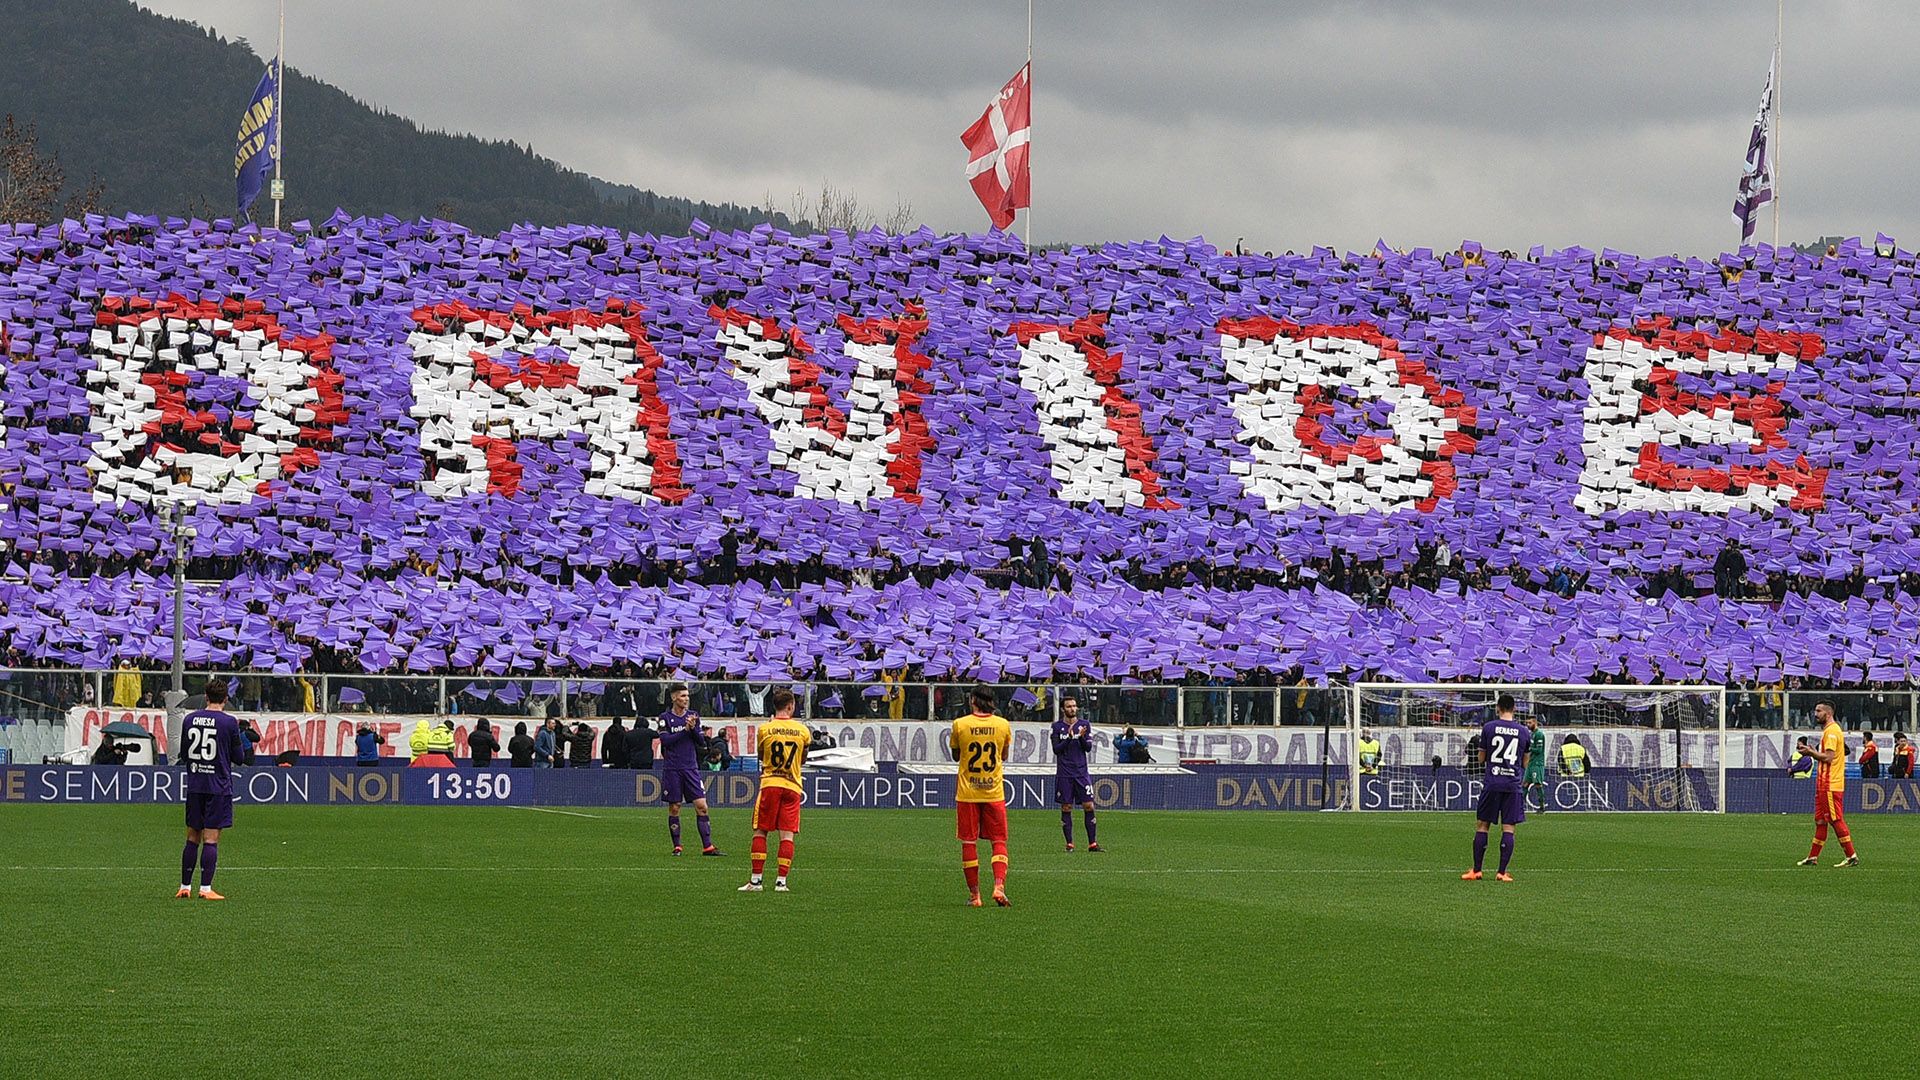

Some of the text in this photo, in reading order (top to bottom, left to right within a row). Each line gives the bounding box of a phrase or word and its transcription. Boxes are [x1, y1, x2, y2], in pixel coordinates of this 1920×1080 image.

[85, 293, 1828, 515] DAVIDE
[192, 716, 216, 727] CHIESA
[767, 728, 801, 737] LOMBARDI
[969, 726, 995, 736] VENUTI
[187, 727, 217, 761] 25
[337, 720, 402, 757] CE
[1177, 733, 1403, 765] VERRANO
[1490, 735, 1519, 765] 24
[771, 740, 798, 770] 87
[968, 741, 996, 773] 23
[0, 770, 25, 800] E
[329, 772, 400, 802] NOI
[427, 772, 512, 800] 13:50
[1094, 778, 1131, 807] OI
[1365, 779, 1485, 808] SEMPR
[1627, 779, 1680, 808] NO
